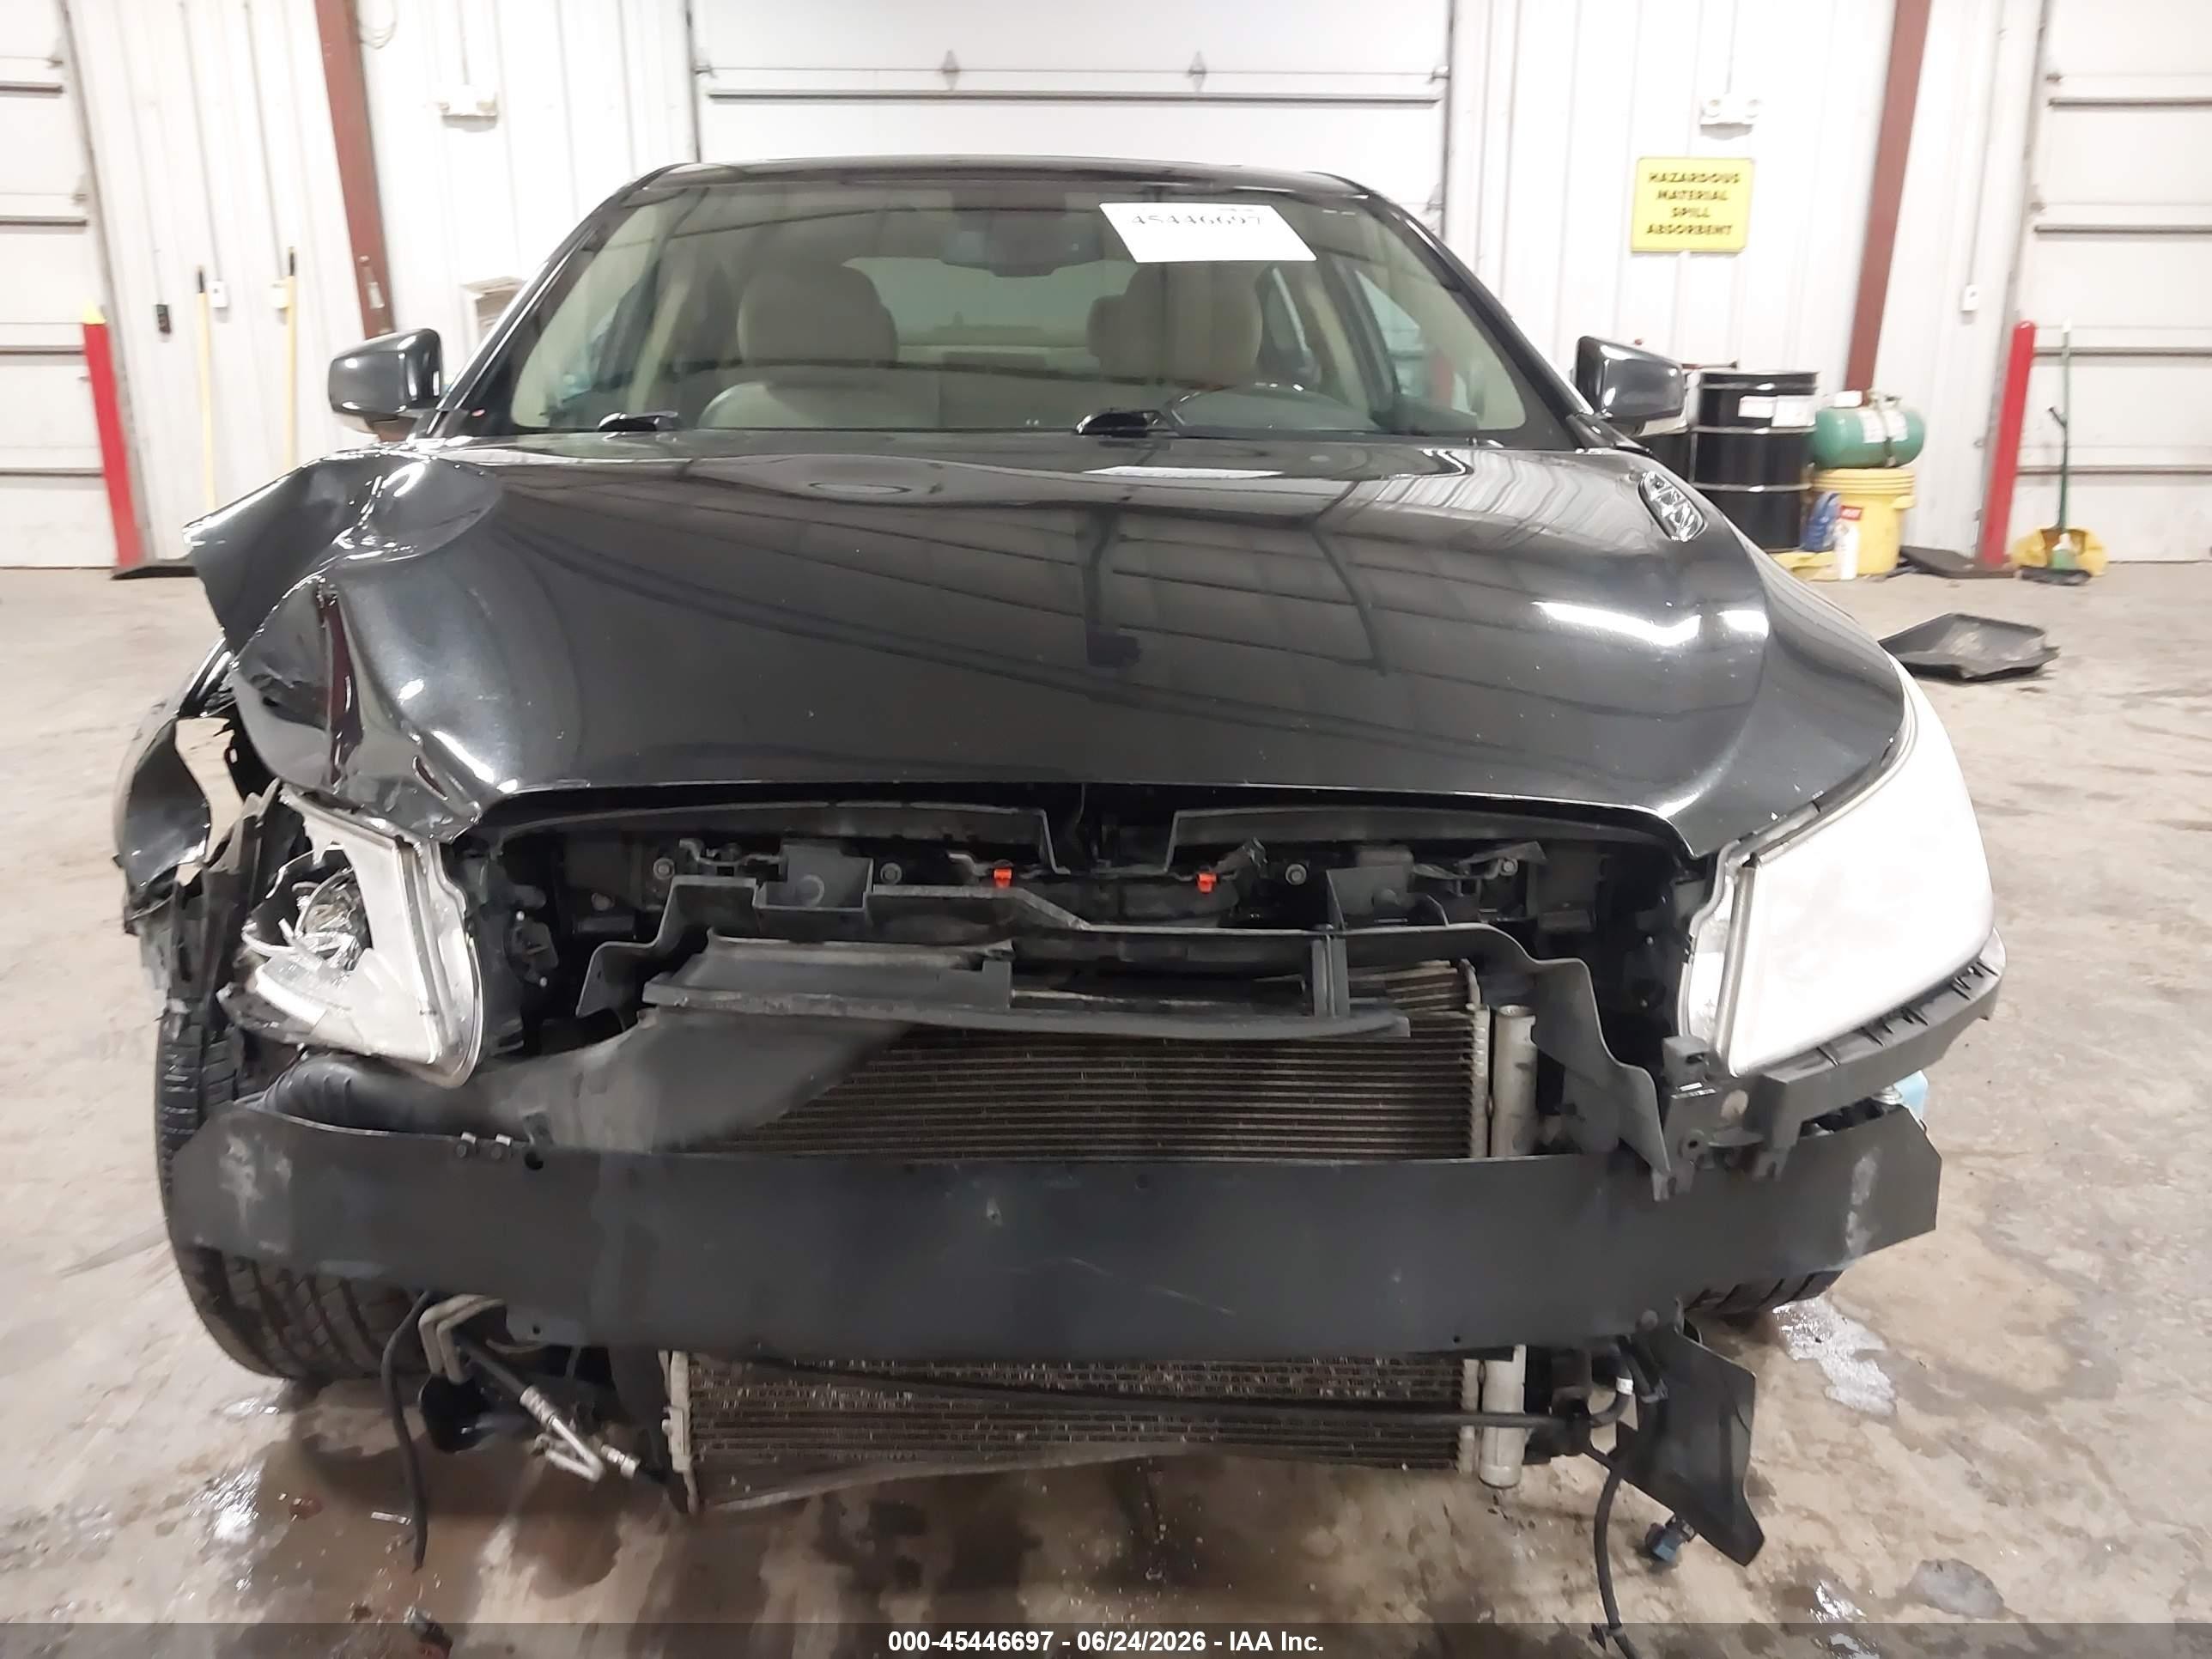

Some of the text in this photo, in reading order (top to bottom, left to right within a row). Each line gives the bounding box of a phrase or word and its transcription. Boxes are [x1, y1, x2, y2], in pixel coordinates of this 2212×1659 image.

[1649, 173, 1741, 183] HAZARDOUS
[1656, 190, 1729, 200] MATERIAL
[1671, 207, 1711, 218] SPILL
[1646, 224, 1733, 234] ABSORBENT
